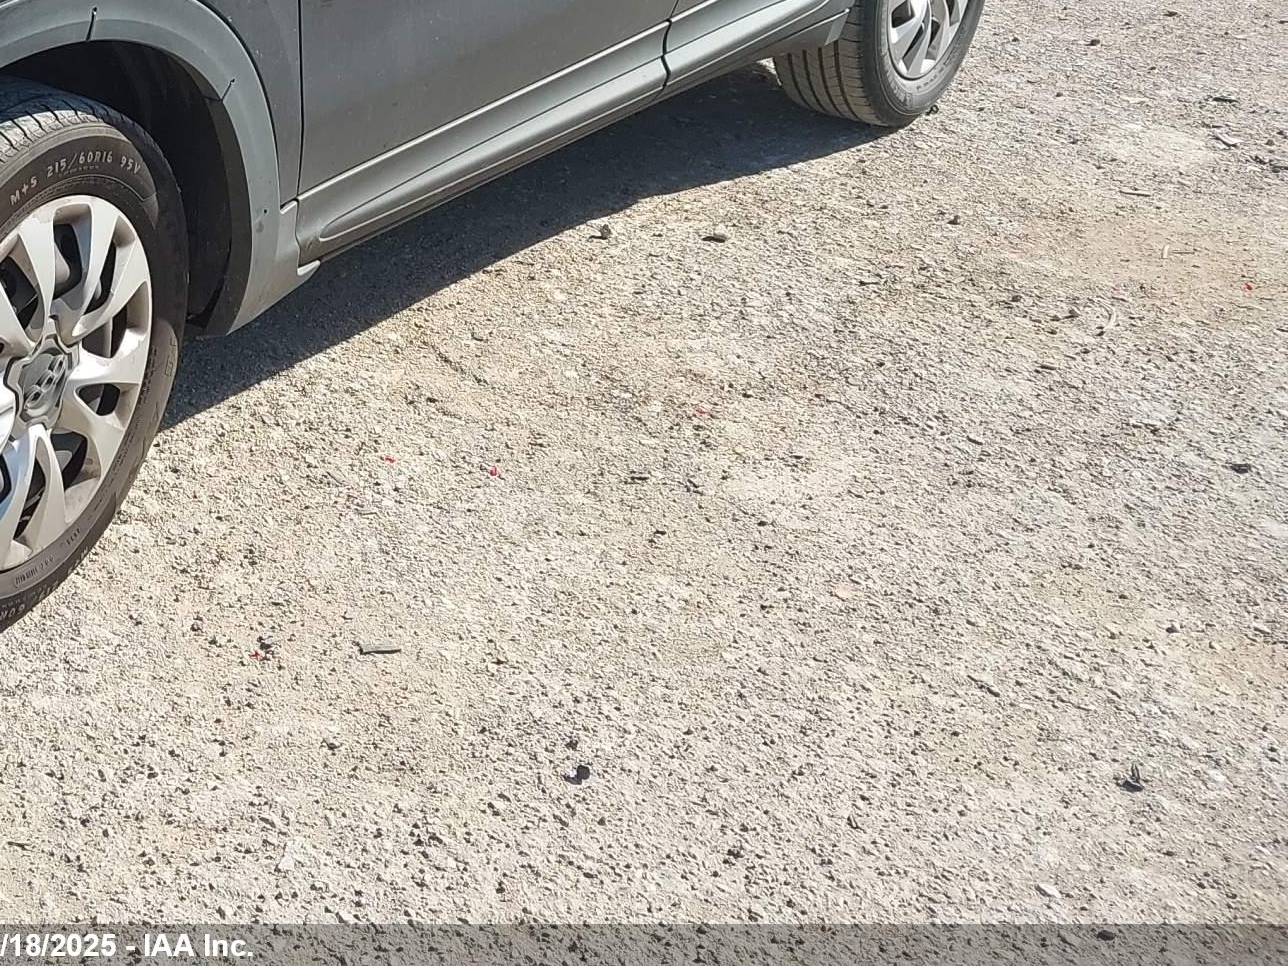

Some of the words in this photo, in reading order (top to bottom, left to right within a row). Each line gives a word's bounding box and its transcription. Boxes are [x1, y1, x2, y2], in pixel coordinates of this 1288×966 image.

[9, 176, 38, 205] M+S
[47, 150, 114, 179] 215/60R16
[120, 155, 141, 175] 95V
